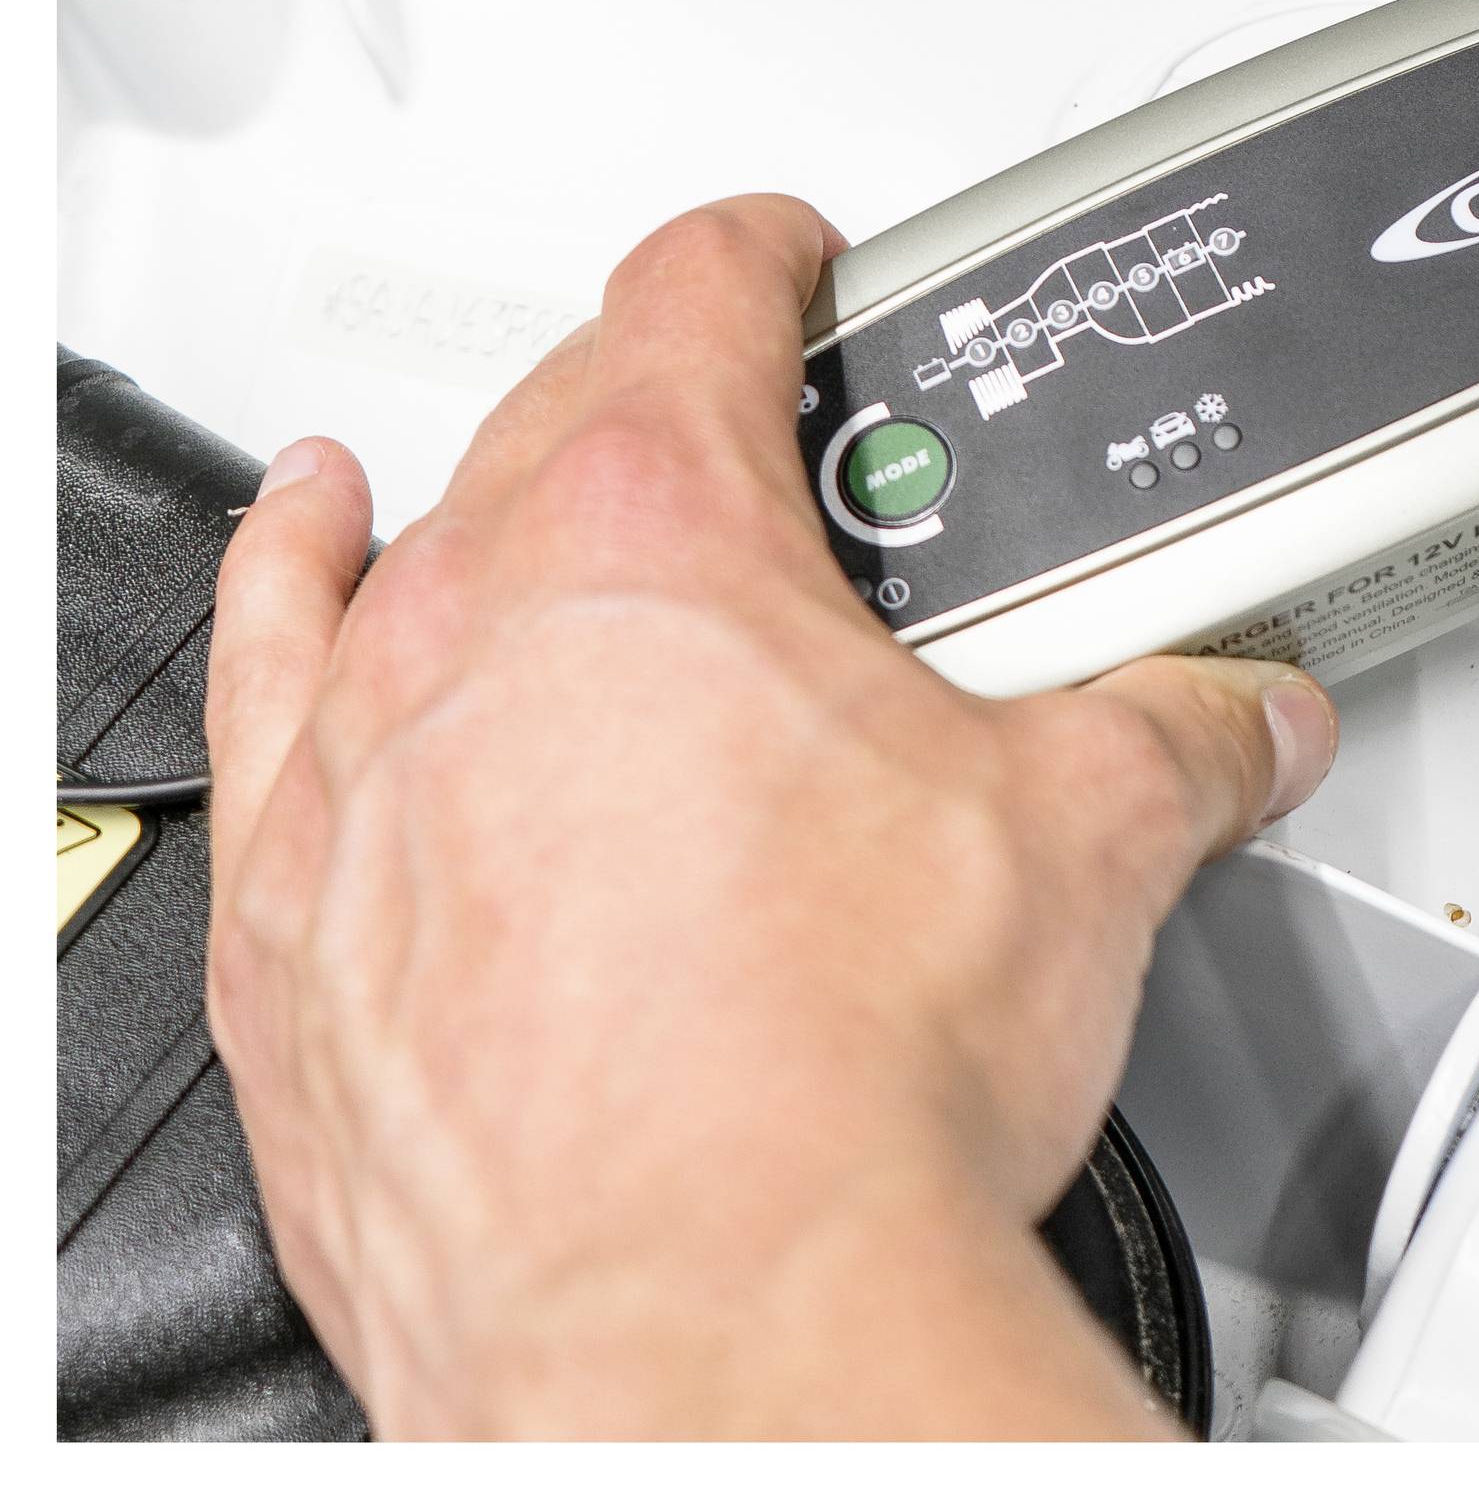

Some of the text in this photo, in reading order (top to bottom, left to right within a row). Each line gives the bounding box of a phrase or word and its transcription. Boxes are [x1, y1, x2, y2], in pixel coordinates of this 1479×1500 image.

[866, 449, 931, 491] MODE
[1198, 599, 1316, 656] ARGER
[1327, 565, 1396, 605] FOR
[1408, 531, 1463, 567] 12V
[1361, 574, 1415, 603] Before
[1392, 575, 1466, 617] Designed
